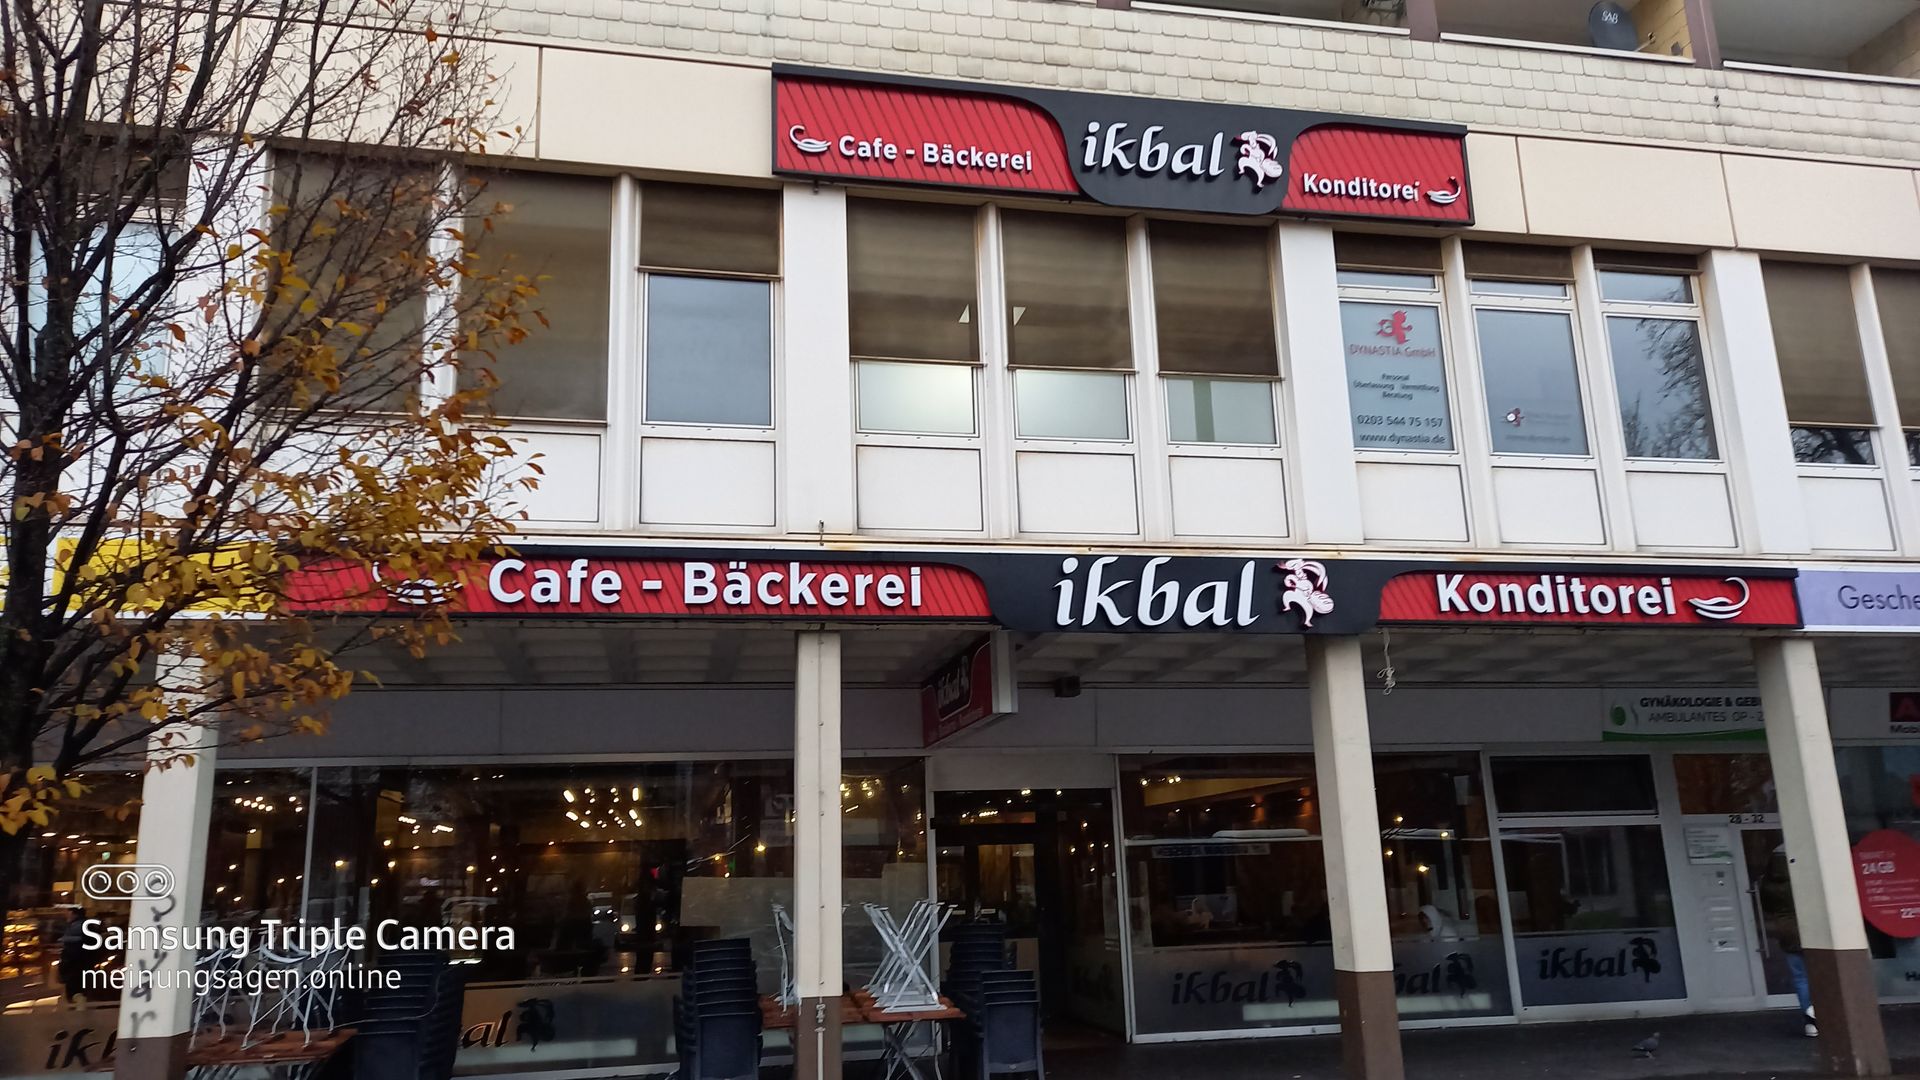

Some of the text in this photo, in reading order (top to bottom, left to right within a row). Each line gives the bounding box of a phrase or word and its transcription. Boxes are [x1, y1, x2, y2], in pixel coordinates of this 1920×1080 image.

[839, 135, 898, 160] Cafe
[923, 142, 1032, 171] Bäckerei
[1082, 121, 1226, 177] ikbal
[1303, 173, 1420, 202] Konditorei
[1349, 344, 1436, 357] DYNASTIA GmbH
[1357, 414, 1383, 425] 0203
[1409, 417, 1422, 427] 75
[1424, 417, 1444, 428] 157
[1360, 432, 1446, 445] www.dynastia.de
[489, 558, 622, 604] Cafe
[684, 561, 921, 607] Bäckerei
[1054, 556, 1260, 627] ikbal
[1436, 574, 1676, 615] Konditorei
[1640, 695, 1722, 707] GYNÄKOLOGIE
[1649, 711, 1726, 723] AMBULANTES
[1732, 711, 1748, 722] OP
[1877, 861, 1895, 873] GB
[1538, 946, 1628, 979] ikbal
[1172, 971, 1270, 1005] ikbal
